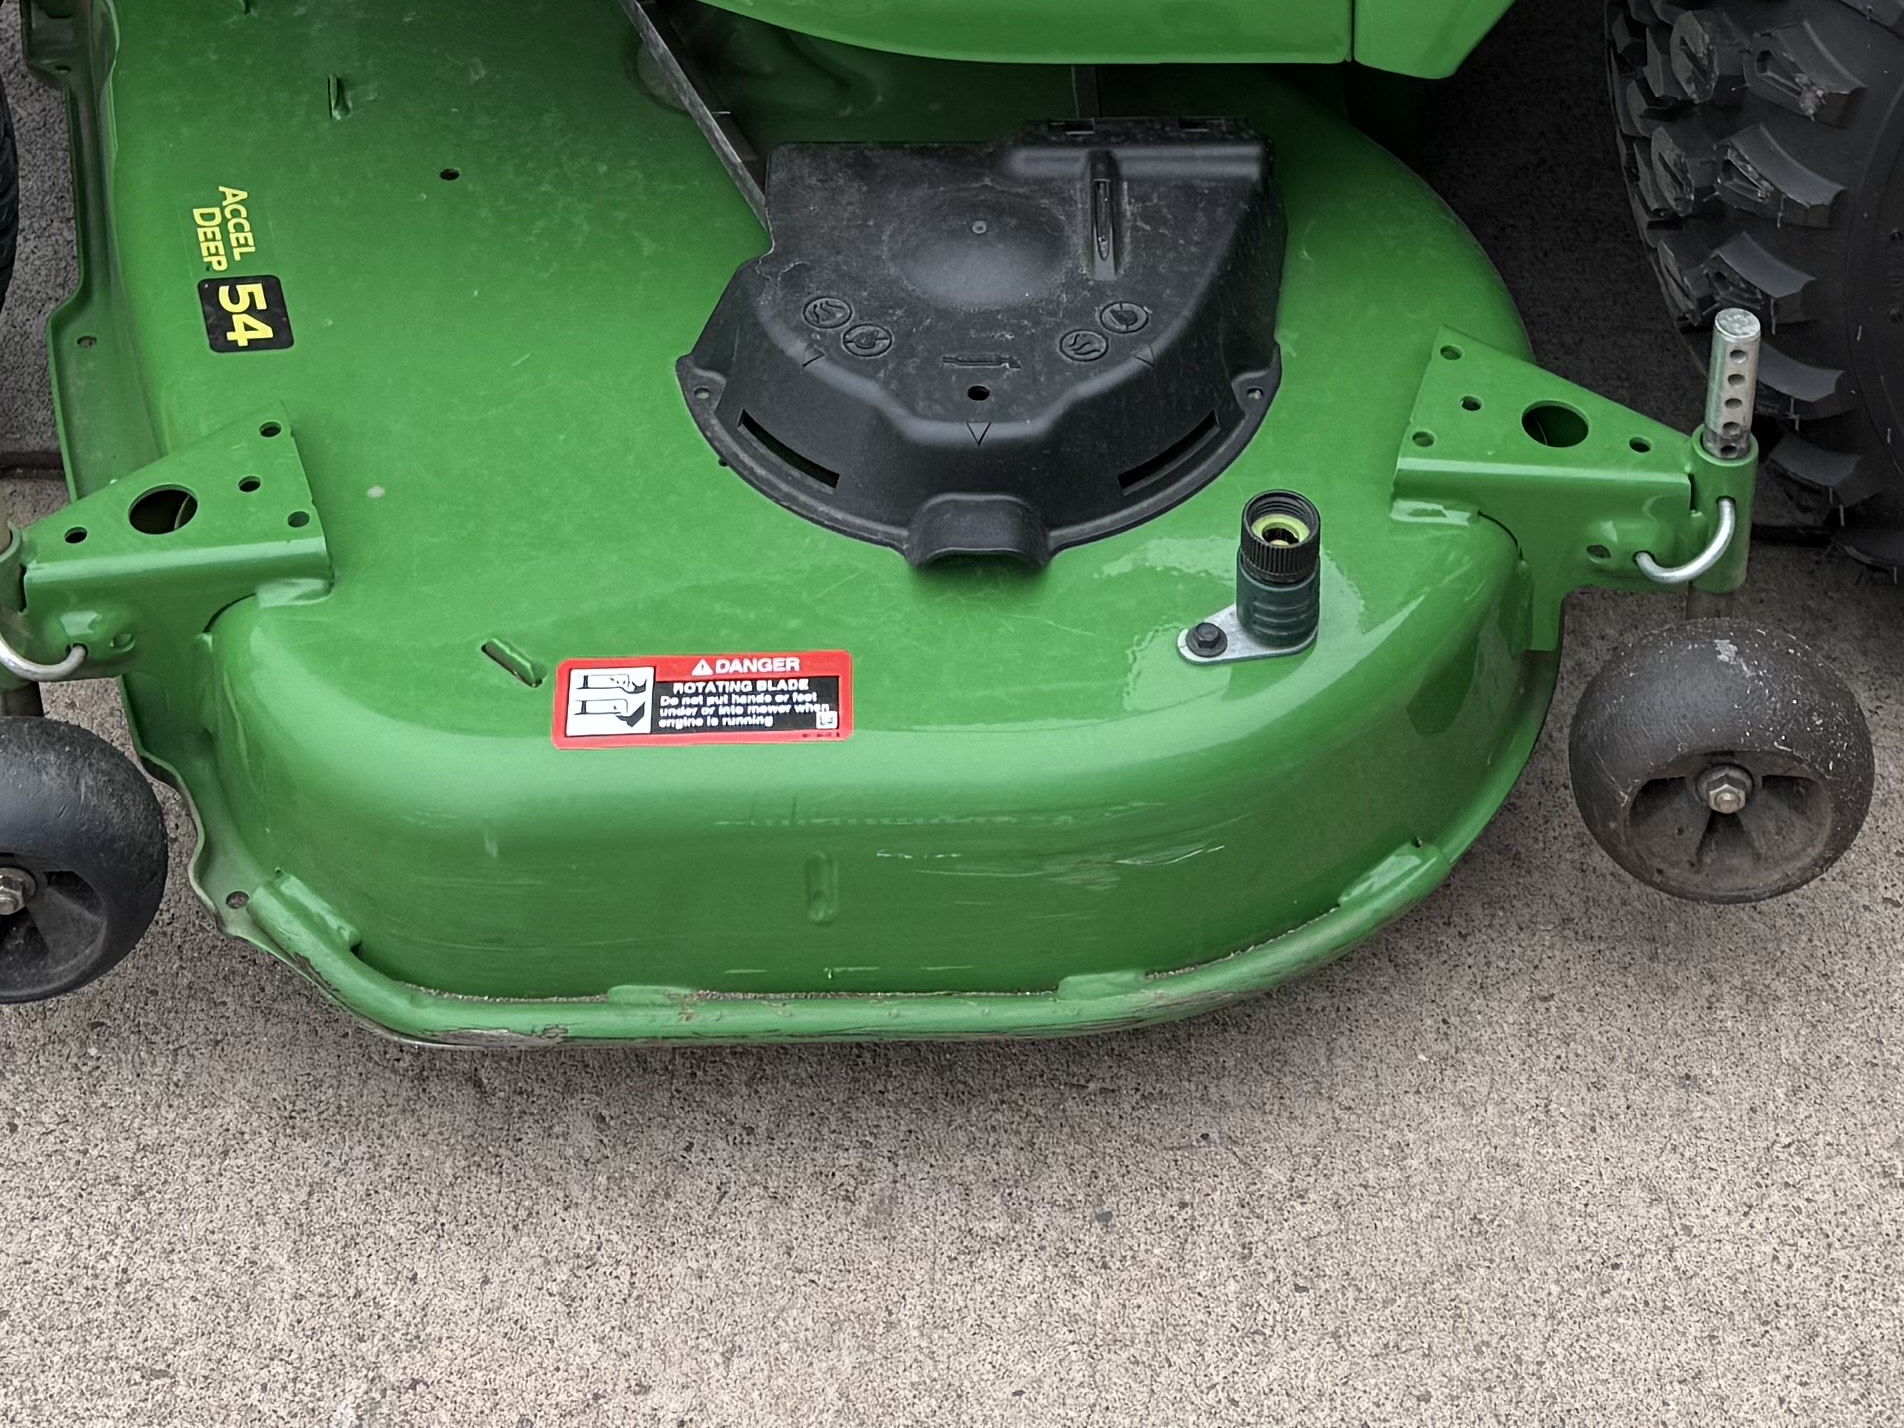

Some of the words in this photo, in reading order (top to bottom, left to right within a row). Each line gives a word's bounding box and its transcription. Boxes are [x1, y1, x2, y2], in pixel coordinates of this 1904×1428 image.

[218, 185, 256, 261] ACCEL
[192, 206, 228, 272] DEEP
[218, 282, 274, 347] 54
[715, 656, 800, 675] DANGER
[673, 680, 755, 695] ROTATING
[757, 678, 809, 692] BLADE
[659, 694, 679, 707] Do
[681, 693, 704, 706] not
[706, 692, 730, 707] put
[721, 715, 774, 729] running
